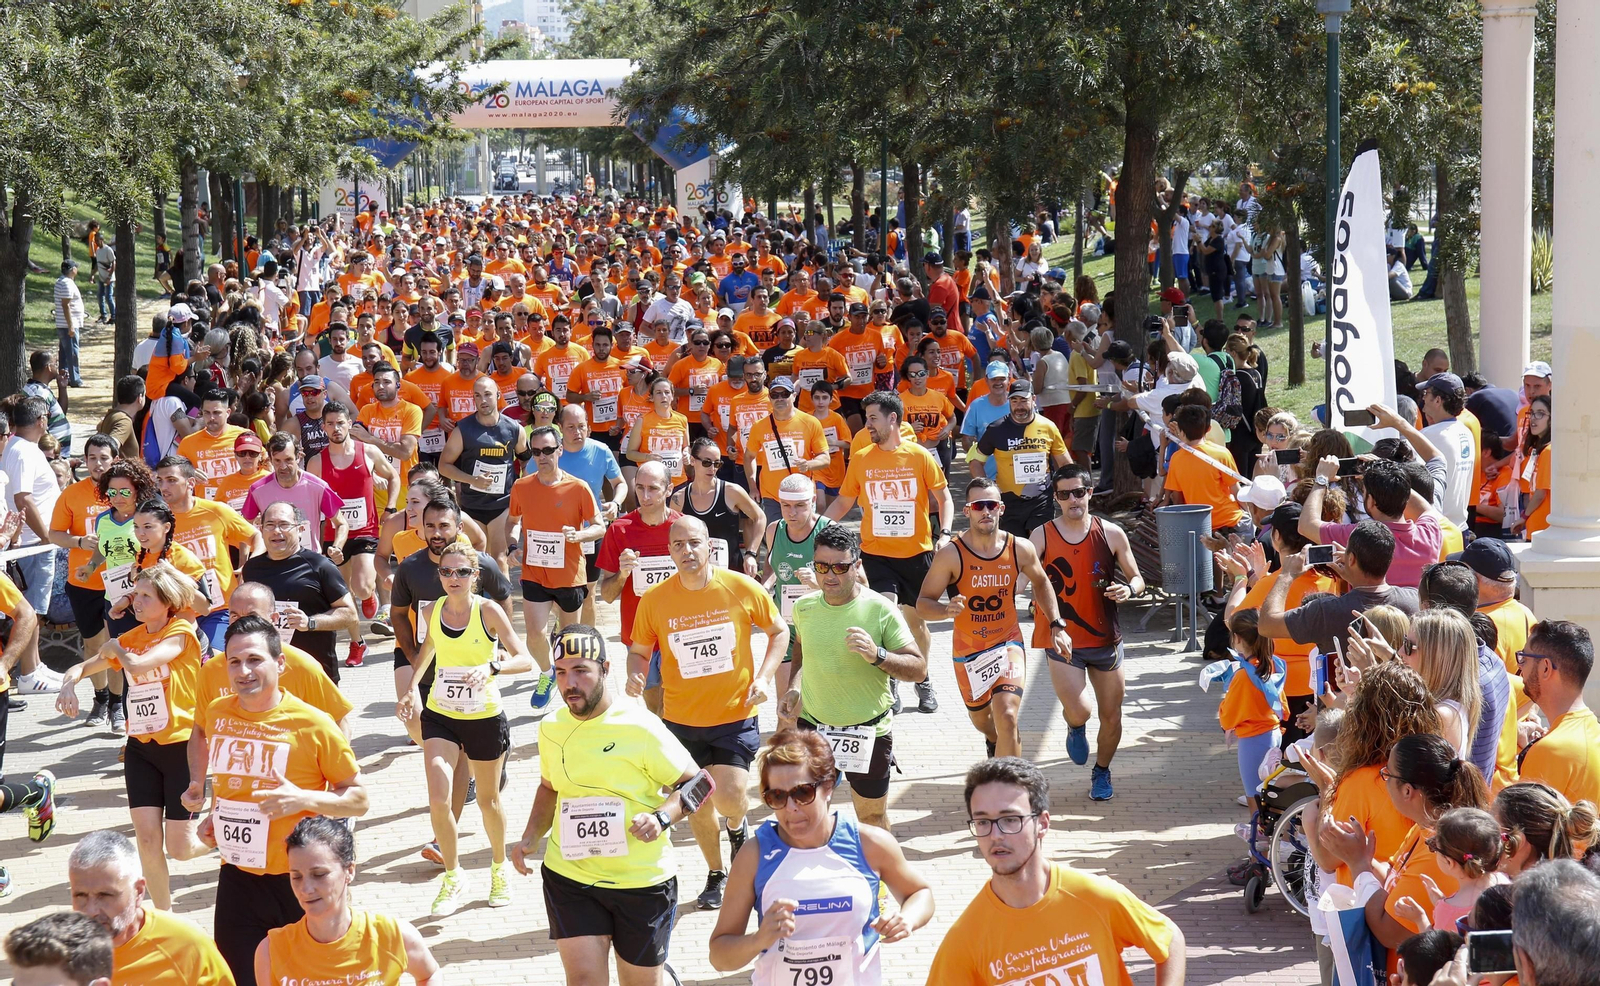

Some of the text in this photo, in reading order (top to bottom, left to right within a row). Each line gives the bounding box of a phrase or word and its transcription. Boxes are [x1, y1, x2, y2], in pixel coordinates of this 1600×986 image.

[515, 77, 604, 98] MÁLAGA
[856, 370, 869, 378] 285
[598, 404, 614, 414] 976
[307, 430, 328, 440] MAY
[425, 438, 440, 446] 919
[1007, 437, 1046, 446] bichos
[480, 448, 505, 457] PUMA
[865, 469, 874, 478] 18
[1023, 464, 1041, 474] 664
[884, 514, 906, 525] 923
[536, 544, 556, 554] 794
[971, 574, 1010, 588] CASTILLO
[998, 588, 1008, 598] fit
[968, 595, 1003, 612] GO
[668, 608, 730, 630] 18 Carrera Urbana
[690, 643, 718, 660] 748
[981, 663, 1001, 682] 528
[446, 686, 472, 698] 571
[136, 702, 158, 718] 402
[214, 718, 226, 732] 18
[832, 738, 860, 754] 758
[222, 824, 252, 844] 646
[577, 820, 610, 838] 648
[794, 901, 850, 912] RELINA
[989, 931, 1090, 980] 18 Carrera Urbana
[1032, 942, 1092, 972] Integración
[346, 970, 382, 985] Urbana
[790, 966, 834, 986] 799
